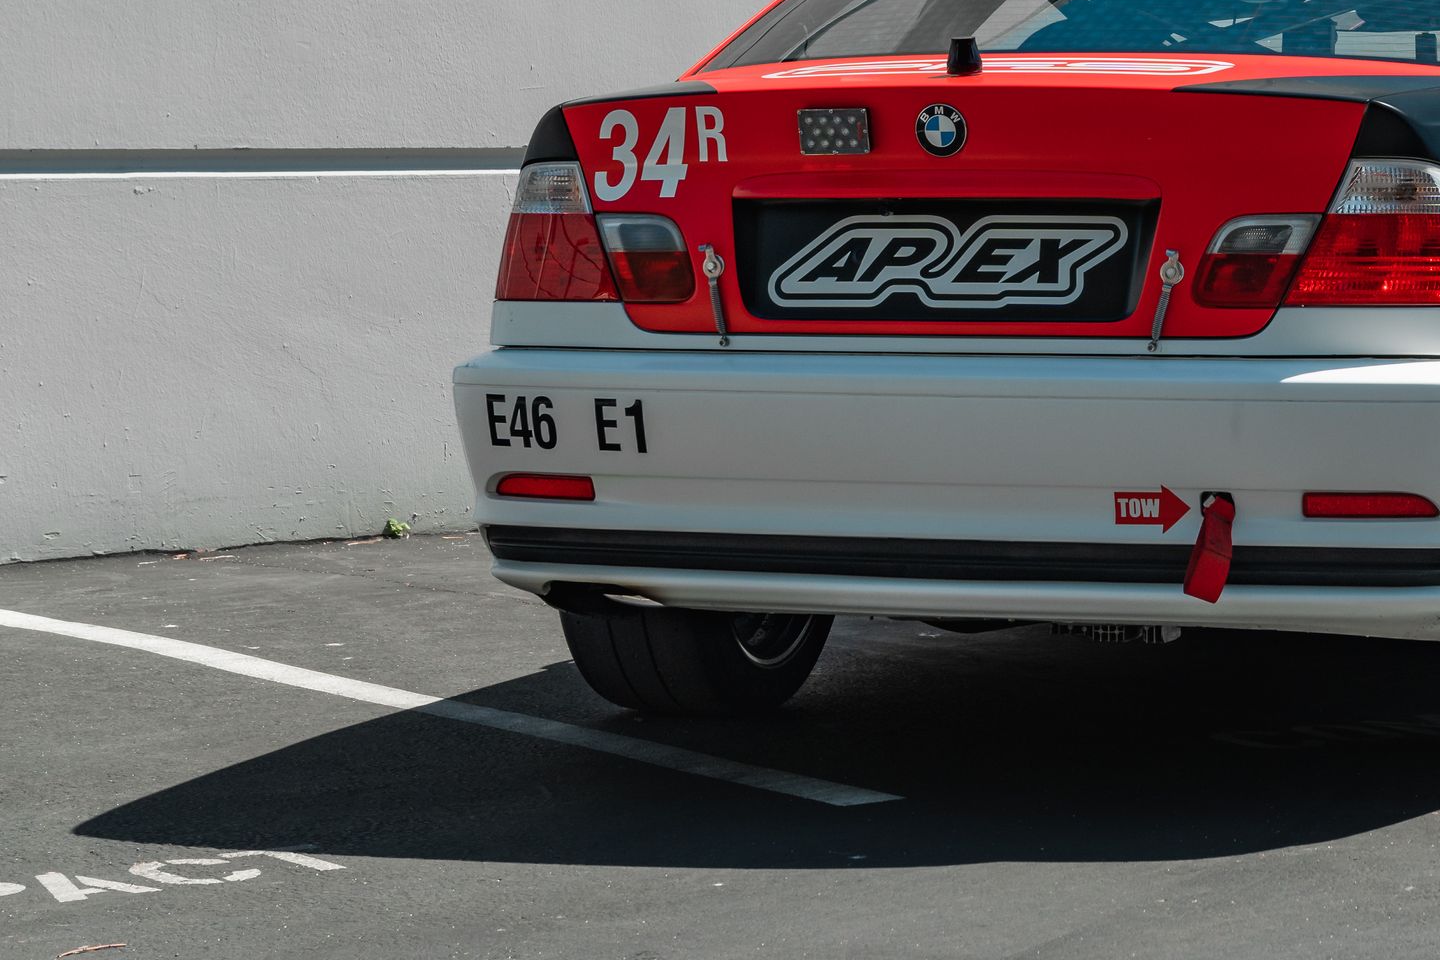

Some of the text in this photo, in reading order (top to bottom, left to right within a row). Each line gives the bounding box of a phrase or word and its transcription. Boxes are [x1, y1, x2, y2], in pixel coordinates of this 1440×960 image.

[919, 106, 962, 124] BMW
[802, 234, 1094, 287] APEX
[485, 393, 648, 454] E46 E1
[1116, 497, 1161, 519] TOW
